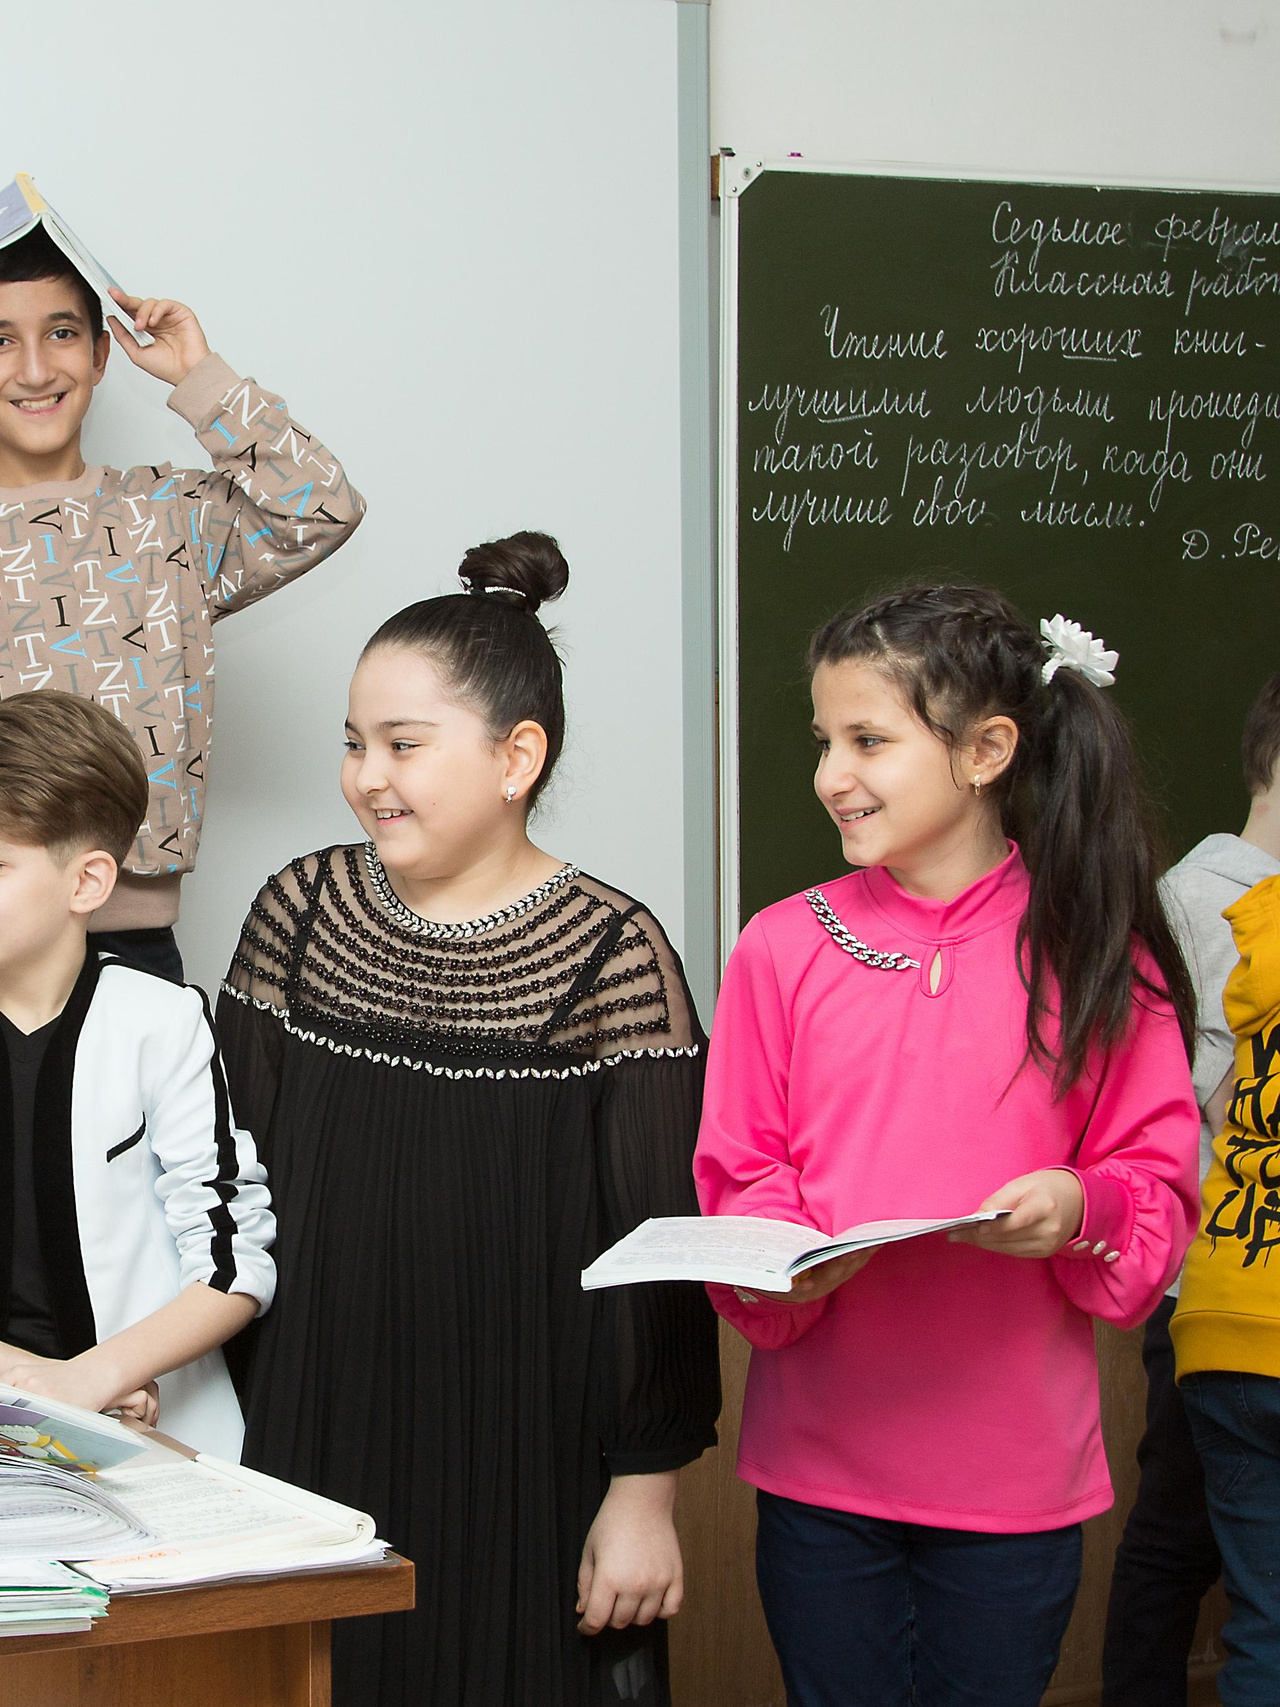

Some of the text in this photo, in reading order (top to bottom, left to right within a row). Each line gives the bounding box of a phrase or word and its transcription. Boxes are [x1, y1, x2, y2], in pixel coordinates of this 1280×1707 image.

[990, 250, 1175, 297] Классная
[992, 201, 1126, 275] Седьмое
[820, 304, 947, 359] Чтение
[975, 323, 1142, 373] хороших
[748, 384, 931, 445] лучшими
[965, 385, 1115, 444] людьми
[753, 428, 878, 474] такой
[1102, 444, 1193, 512] когда
[1210, 449, 1267, 481] они
[752, 489, 893, 552] лучшие
[912, 475, 986, 527] свои
